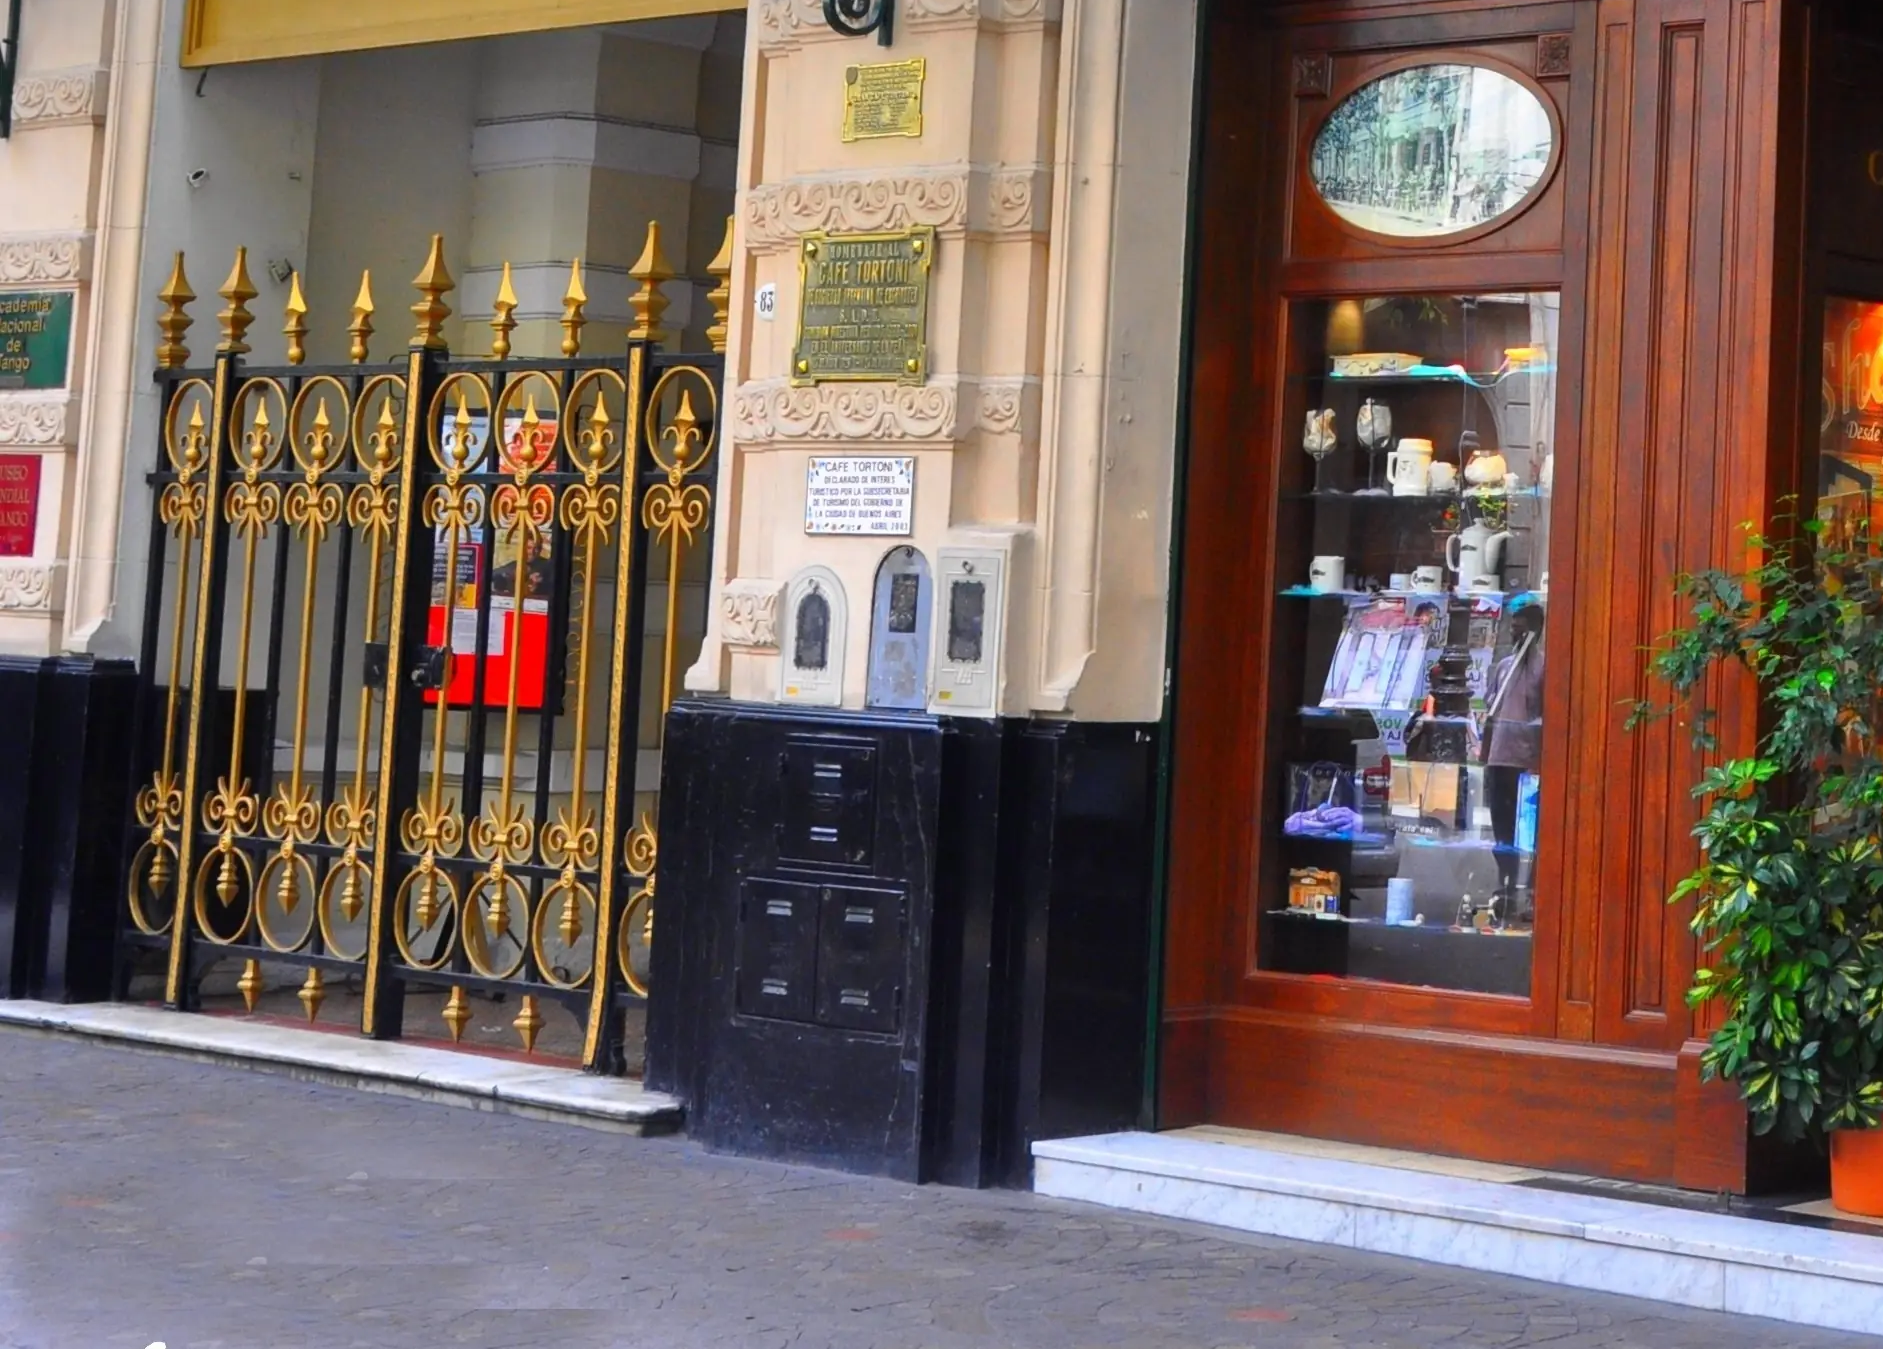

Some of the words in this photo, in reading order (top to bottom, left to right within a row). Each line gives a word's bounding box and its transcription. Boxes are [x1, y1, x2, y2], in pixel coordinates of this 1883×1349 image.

[0, 317, 43, 333] acional
[6, 337, 22, 353] de
[1848, 420, 1881, 443] Desde
[825, 461, 849, 472] CAFE
[853, 461, 893, 472] TORTONI
